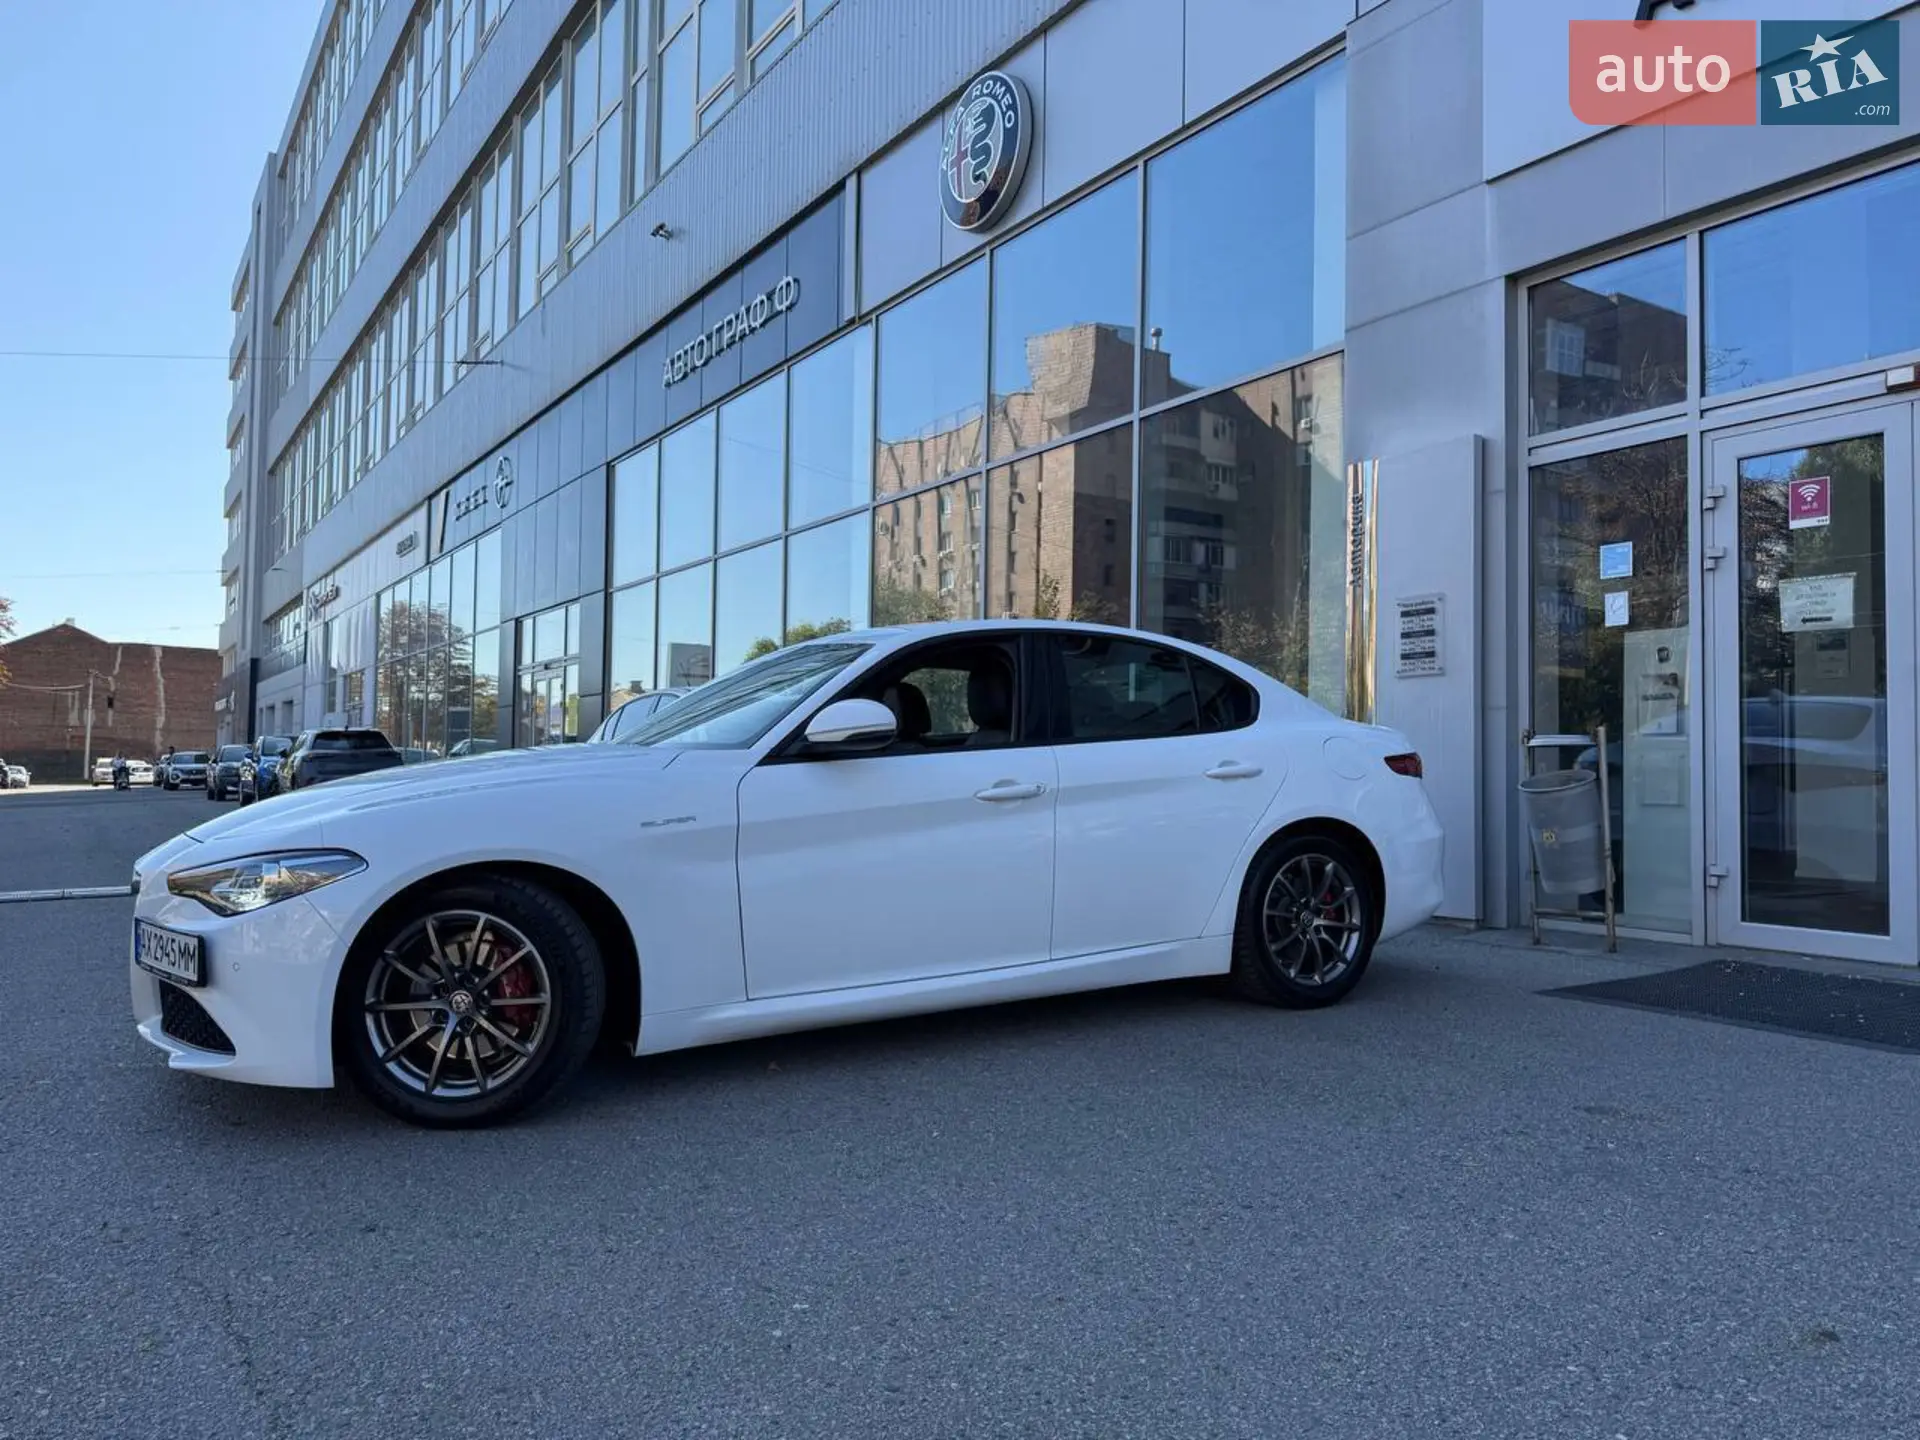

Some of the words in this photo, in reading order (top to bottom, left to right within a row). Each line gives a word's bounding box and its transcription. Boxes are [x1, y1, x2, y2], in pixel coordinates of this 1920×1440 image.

[971, 79, 1016, 129] ROMEO
[153, 933, 177, 967] 2945
[178, 941, 197, 974] MM
